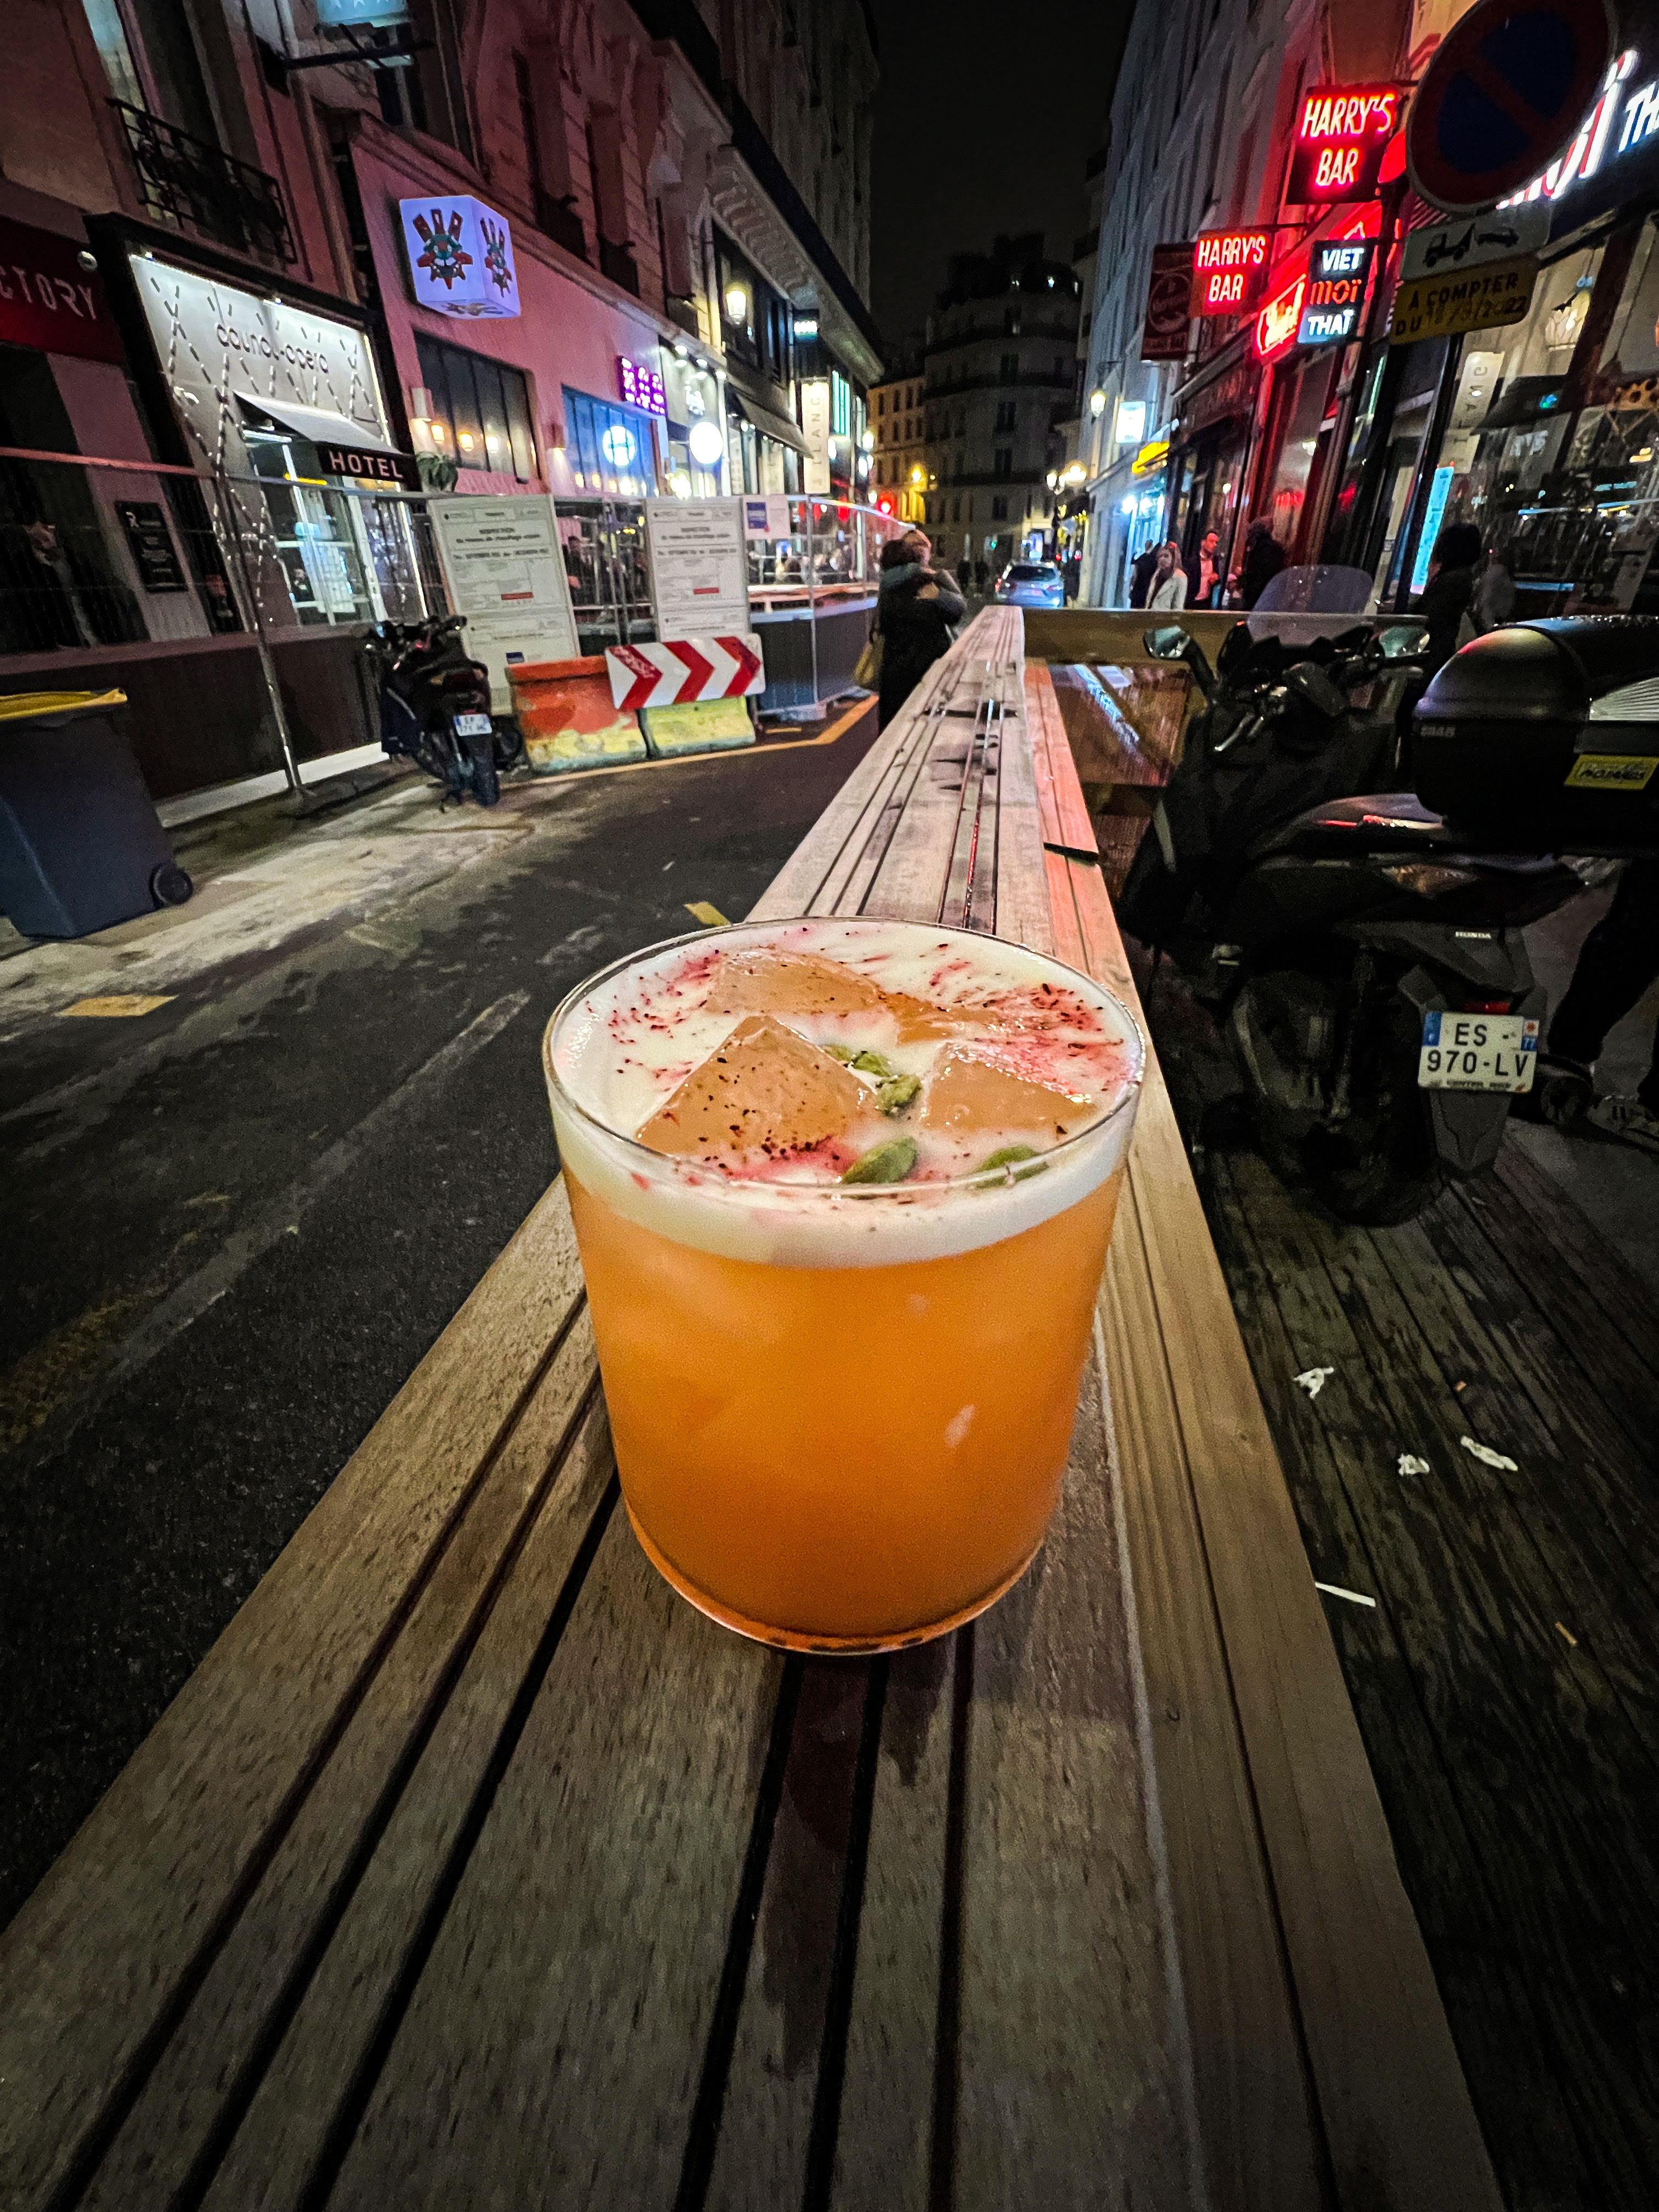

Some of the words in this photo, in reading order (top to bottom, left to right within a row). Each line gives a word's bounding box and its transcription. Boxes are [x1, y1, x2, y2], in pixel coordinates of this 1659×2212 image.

[1300, 93, 1395, 138] HARRY'S
[1316, 148, 1359, 187] BAR
[1197, 235, 1266, 268] HARRY'S
[1322, 248, 1364, 272] VIET
[1208, 274, 1244, 302] BAR
[1427, 272, 1519, 307] COMPTER
[1308, 309, 1354, 336] THAÏ
[1395, 315, 1422, 336] DU
[329, 450, 403, 478] HOTEL
[1427, 1049, 1528, 1077] 970-LV
